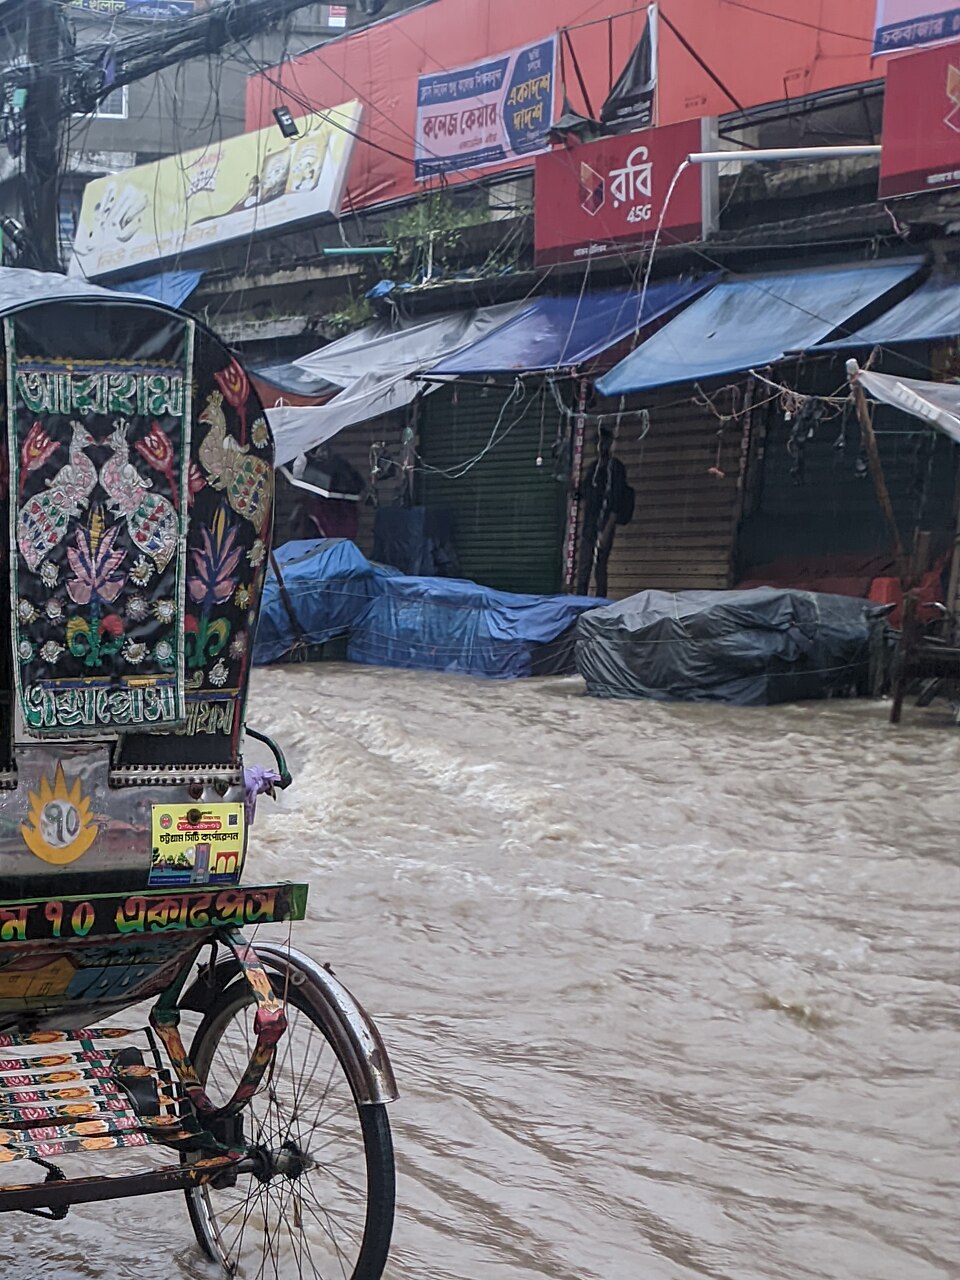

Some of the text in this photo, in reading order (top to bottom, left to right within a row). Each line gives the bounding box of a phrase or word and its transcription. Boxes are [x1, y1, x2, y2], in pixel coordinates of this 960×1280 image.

[881, 17, 946, 44] চকবাজার
[507, 71, 551, 106] একাদশ
[422, 102, 498, 140] কলেজ কেয়ার
[512, 102, 544, 131] দ্বাদশ
[608, 145, 654, 208] রবি
[15, 371, 184, 417] আরহাম
[44, 803, 81, 843] ৭০
[159, 830, 239, 845] চট্টগ্রাম সিটি কর্পোরেশন
[44, 900, 96, 938] ৭০
